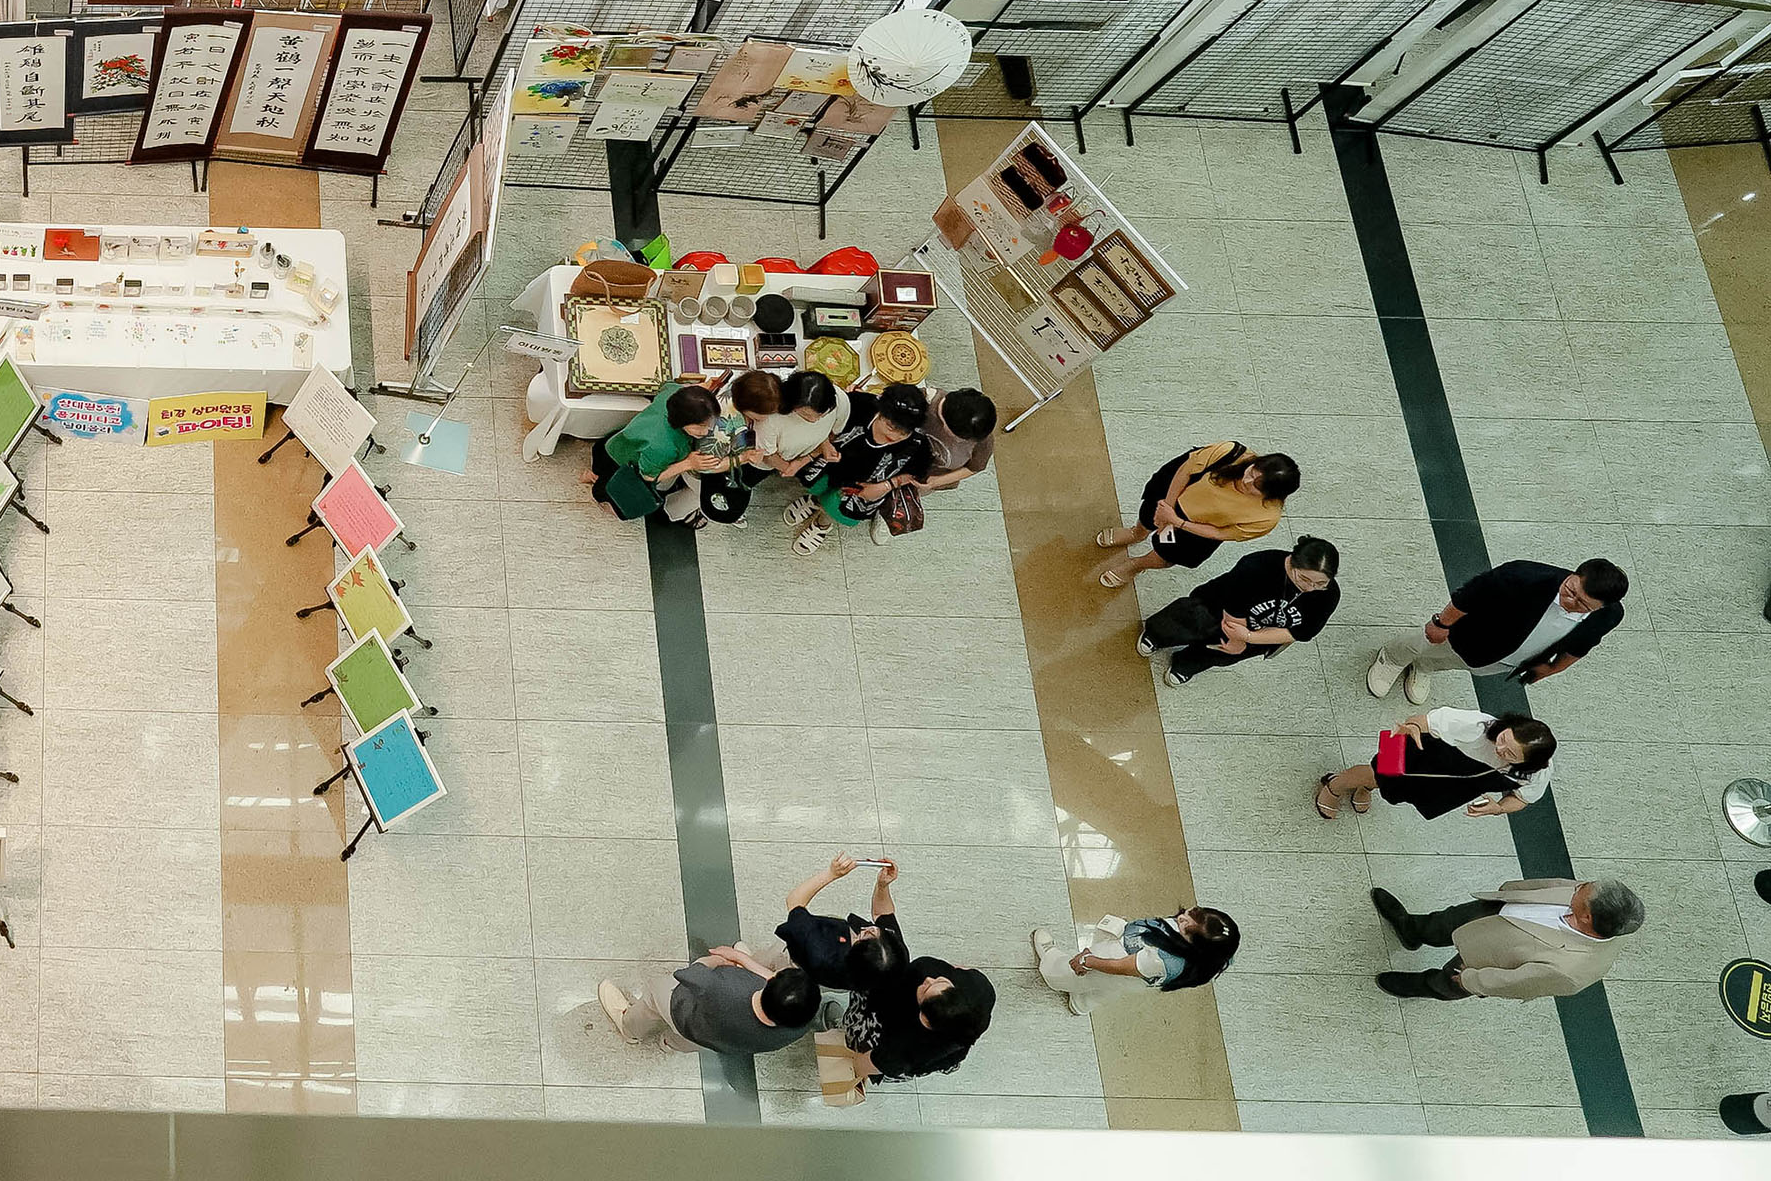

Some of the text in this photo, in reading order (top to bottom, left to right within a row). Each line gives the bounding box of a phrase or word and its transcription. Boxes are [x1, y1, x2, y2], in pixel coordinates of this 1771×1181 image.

[161, 409, 186, 420] 최강
[176, 416, 253, 434] 파이팅!
[1250, 599, 1289, 616] UNITD
